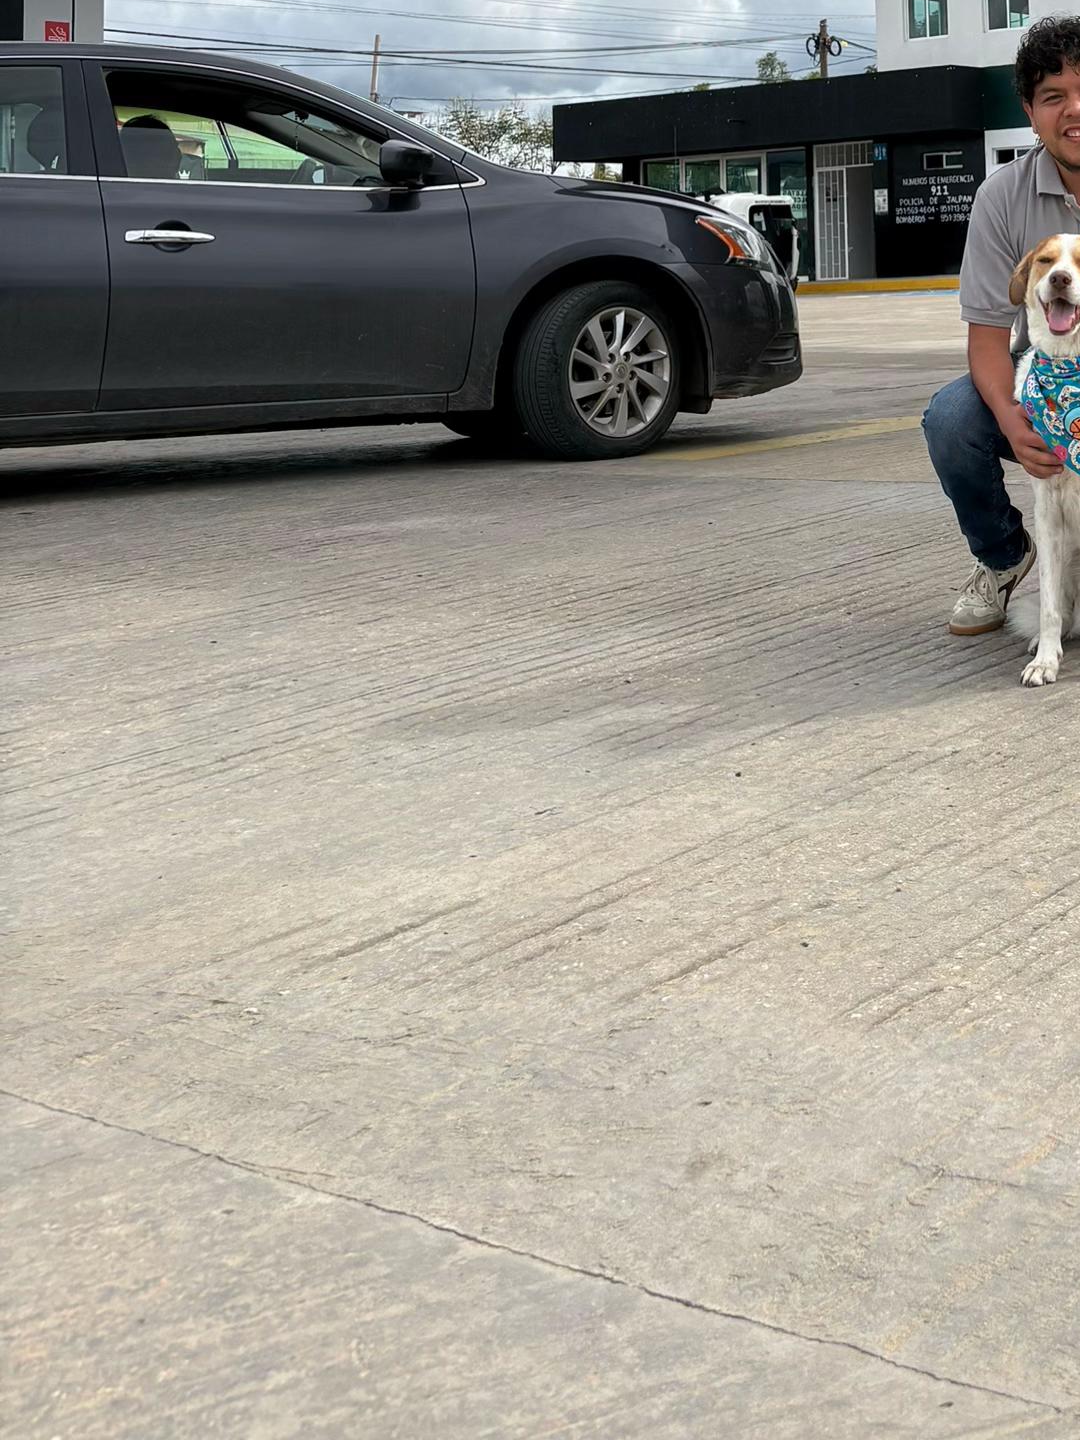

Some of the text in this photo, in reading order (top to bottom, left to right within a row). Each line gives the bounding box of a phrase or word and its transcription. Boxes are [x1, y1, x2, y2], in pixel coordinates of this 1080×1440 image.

[928, 176, 936, 185] DE
[937, 174, 974, 184] EMERGENCIA
[930, 185, 949, 196] 911
[899, 195, 972, 207] POLICIA DE JALPAN
